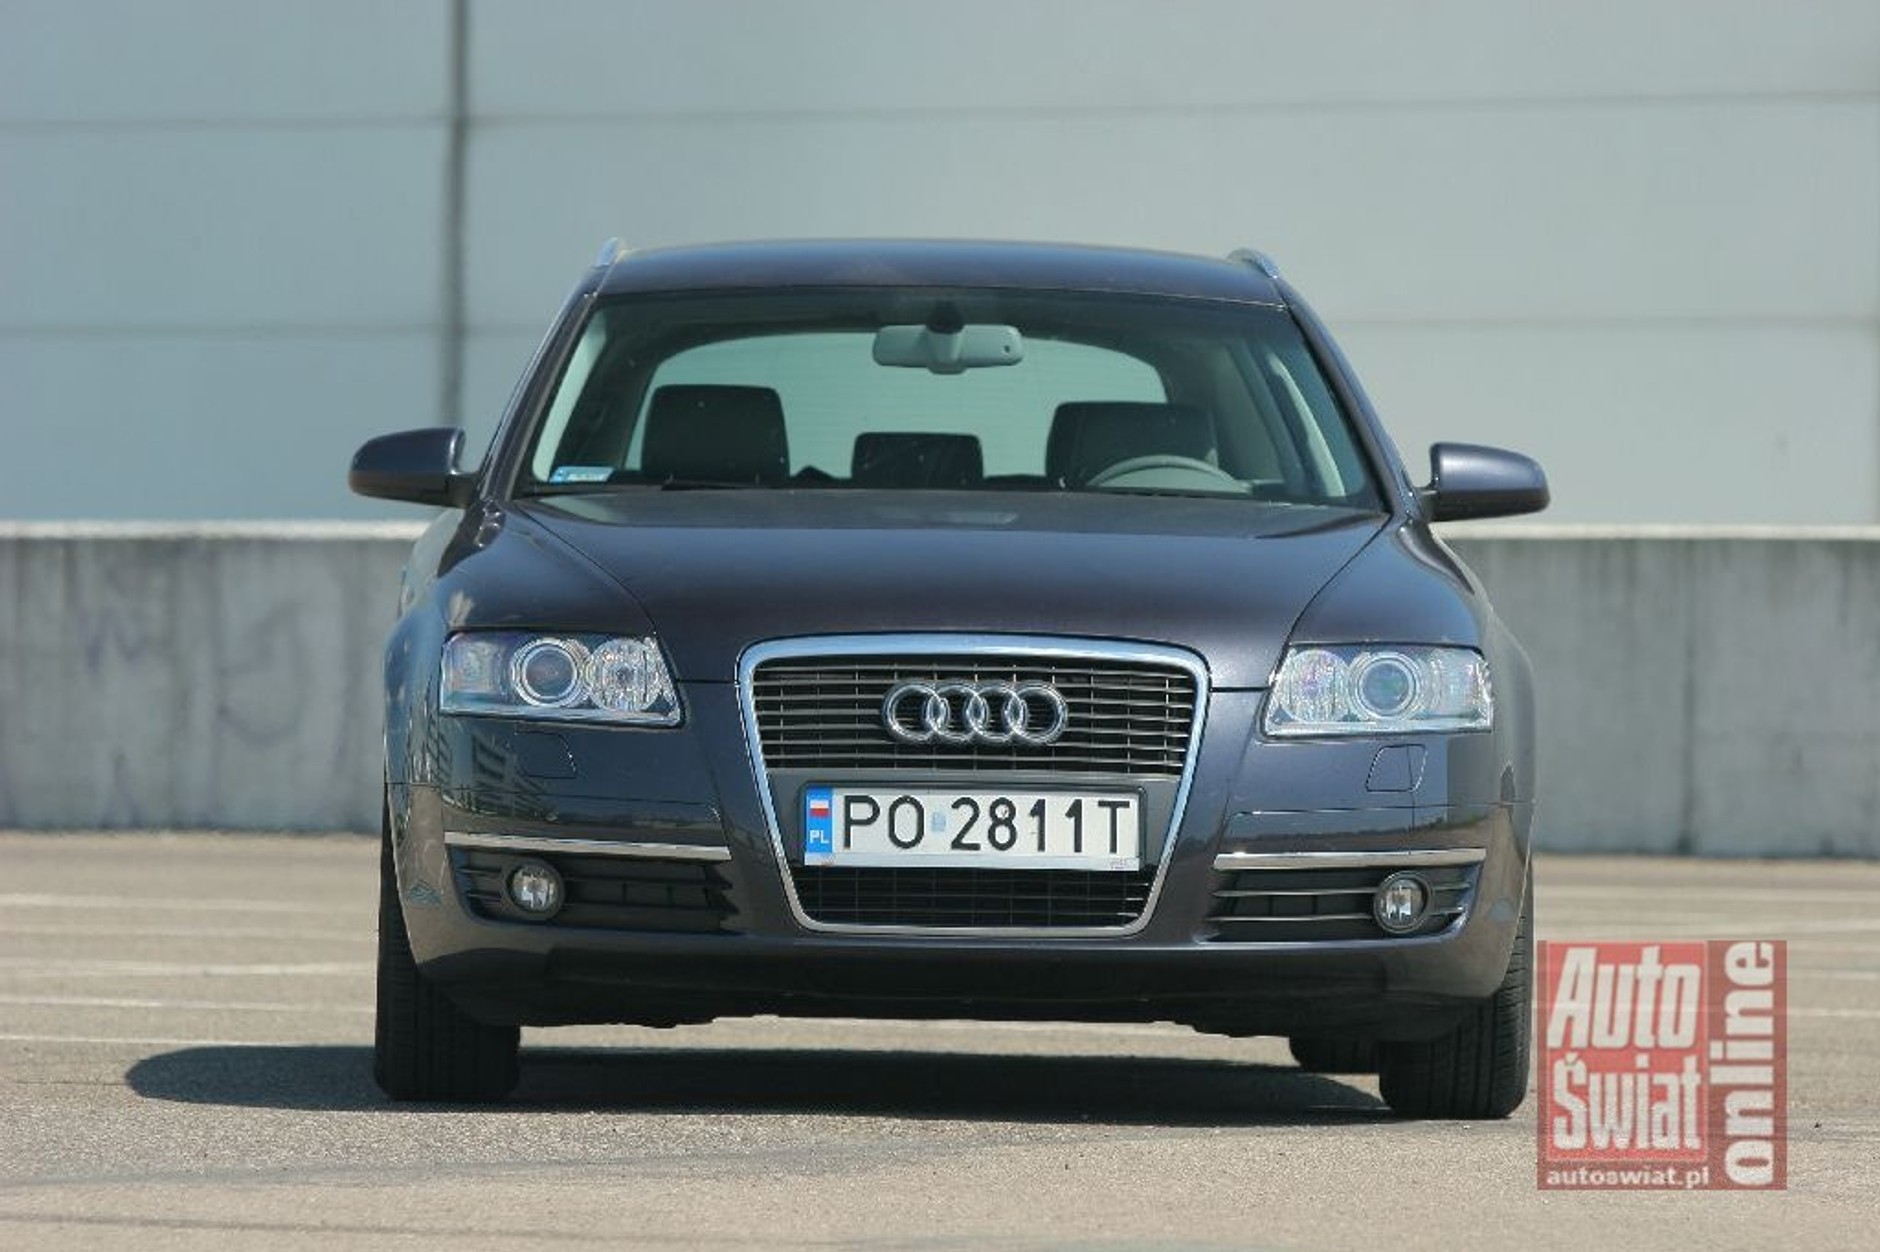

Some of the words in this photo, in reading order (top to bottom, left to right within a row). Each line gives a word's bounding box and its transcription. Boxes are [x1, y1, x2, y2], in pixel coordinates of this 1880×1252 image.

[809, 830, 830, 845] PL
[843, 795, 925, 850] PO
[950, 796, 1130, 854] 2811T
